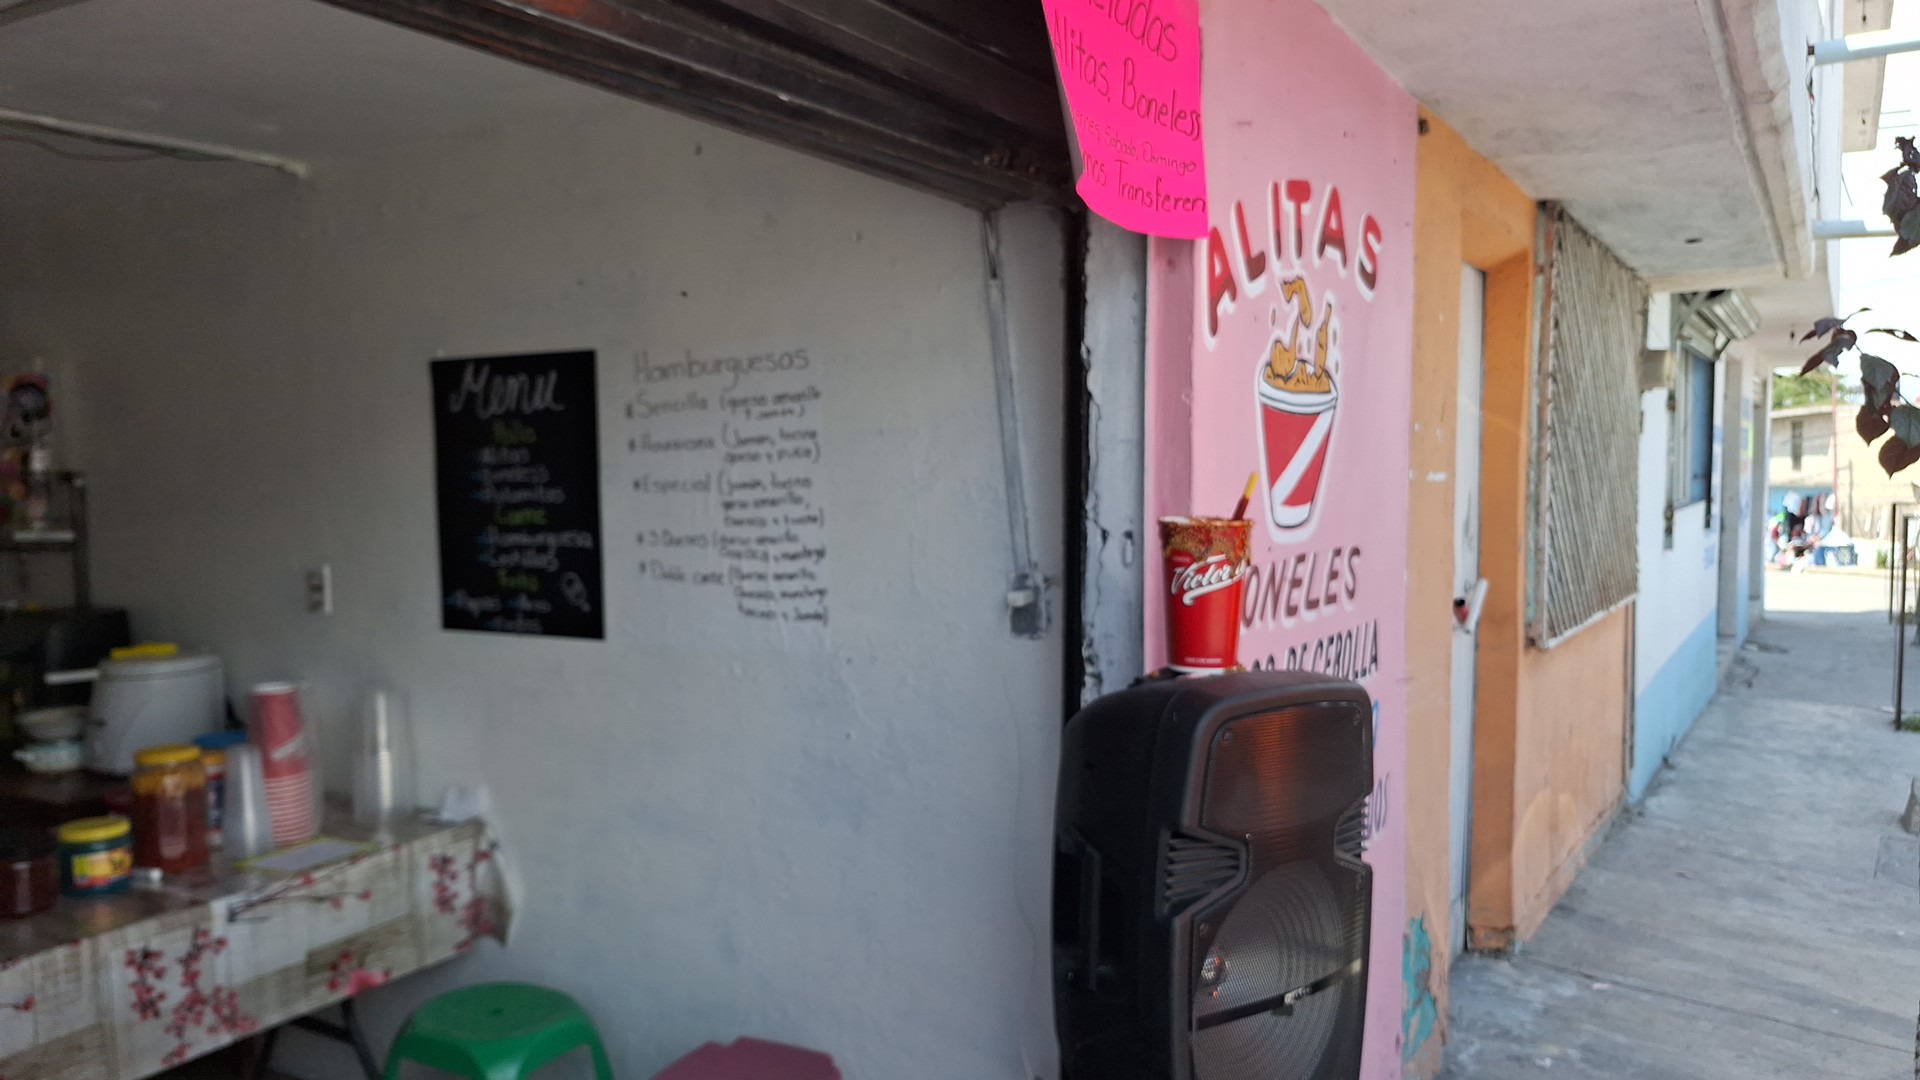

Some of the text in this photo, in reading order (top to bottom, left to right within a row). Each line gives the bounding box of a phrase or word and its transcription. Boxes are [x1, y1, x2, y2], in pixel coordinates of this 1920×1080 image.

[1121, 56, 1202, 141] Boneless
[1203, 178, 1382, 338] ALITAS
[449, 361, 566, 420] Menu
[1243, 546, 1361, 628] ONELES
